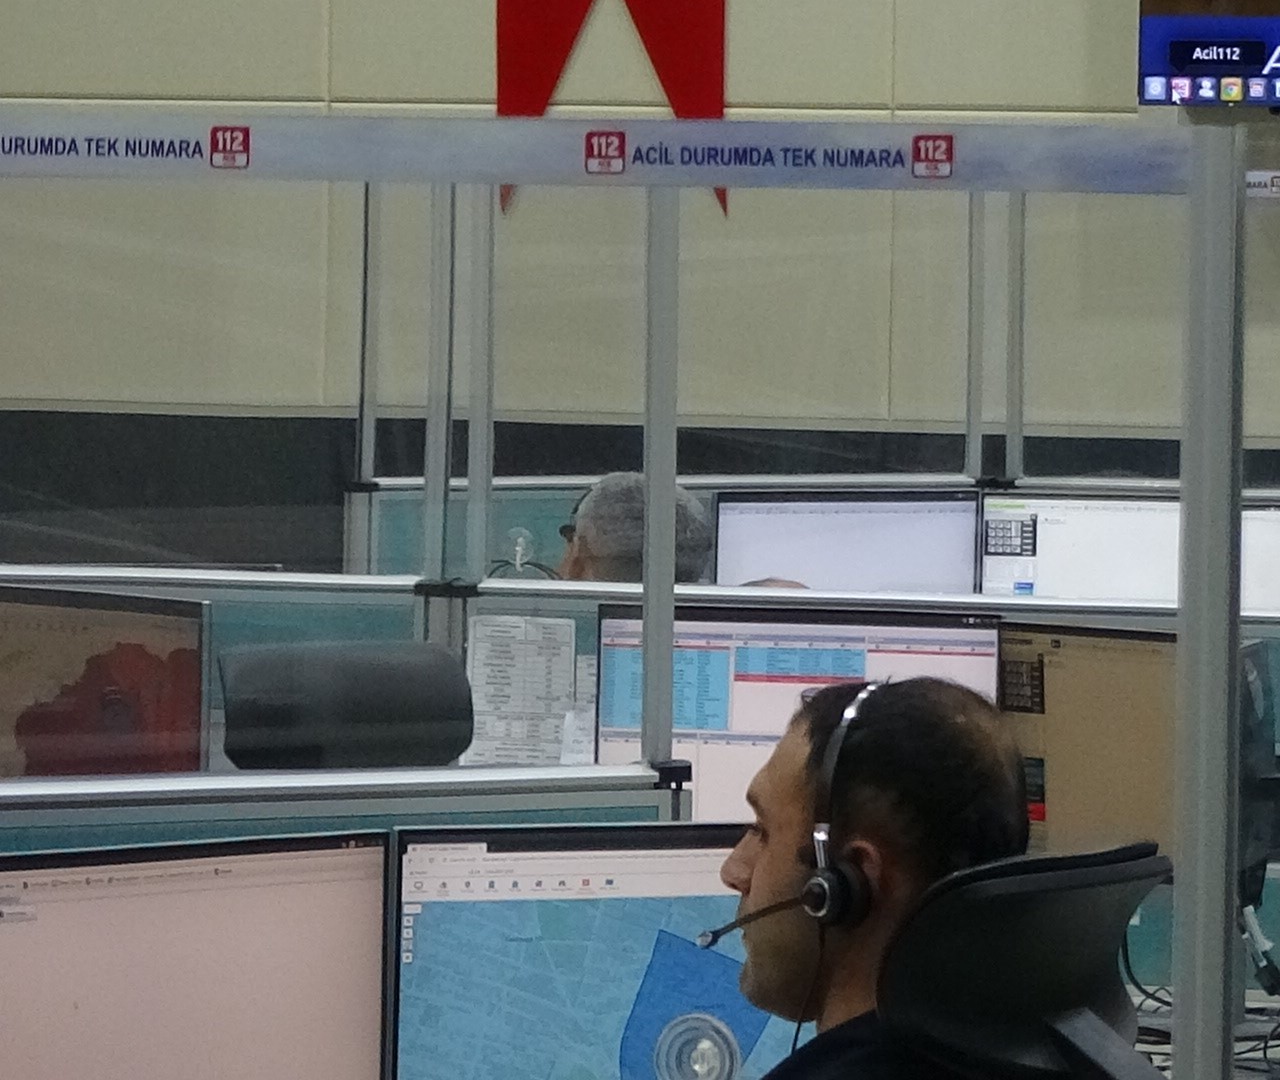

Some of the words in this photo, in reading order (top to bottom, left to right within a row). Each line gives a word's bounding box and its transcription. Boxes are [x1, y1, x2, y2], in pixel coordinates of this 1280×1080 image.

[1193, 46, 1241, 61] Acil112
[85, 137, 119, 157] TEK
[125, 138, 204, 159] NUMARA
[216, 130, 244, 151] 112
[590, 135, 620, 157] 112
[632, 141, 674, 167] ACİL
[681, 146, 775, 168] DURUMDA
[781, 147, 815, 168] TEK
[823, 147, 905, 169] NUMARA
[918, 139, 946, 161] 112
